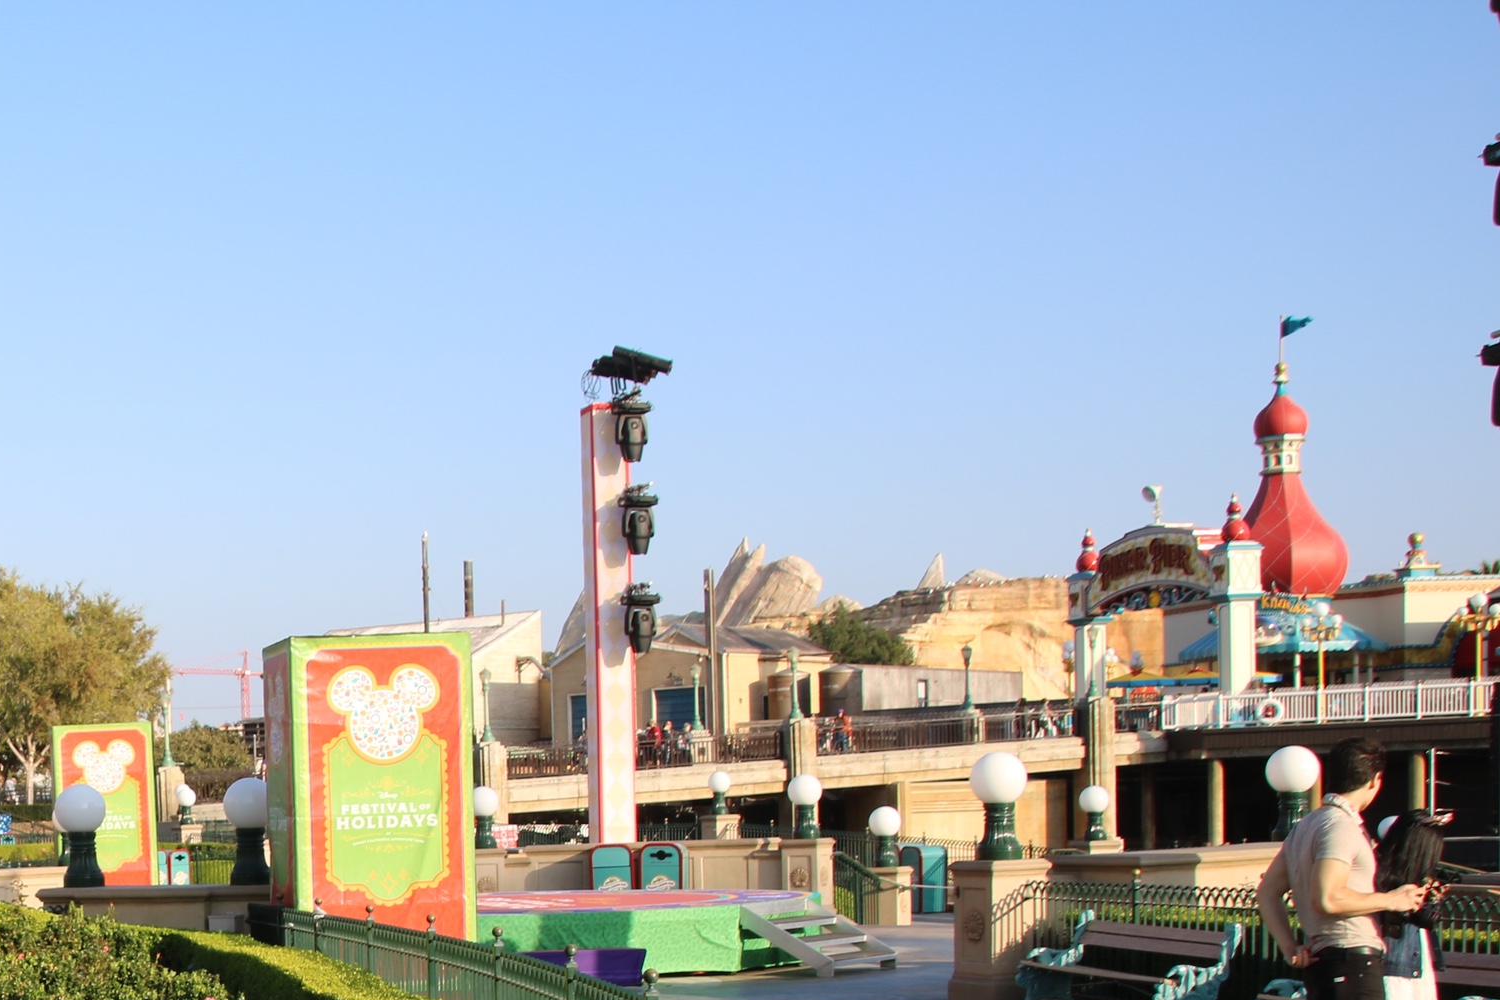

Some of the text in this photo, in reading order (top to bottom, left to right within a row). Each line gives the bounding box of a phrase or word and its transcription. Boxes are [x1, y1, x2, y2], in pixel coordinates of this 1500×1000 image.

[341, 802, 417, 815] FESTIVAL
[97, 820, 136, 830] IDAYS
[336, 813, 438, 830] HOLIDAYS
